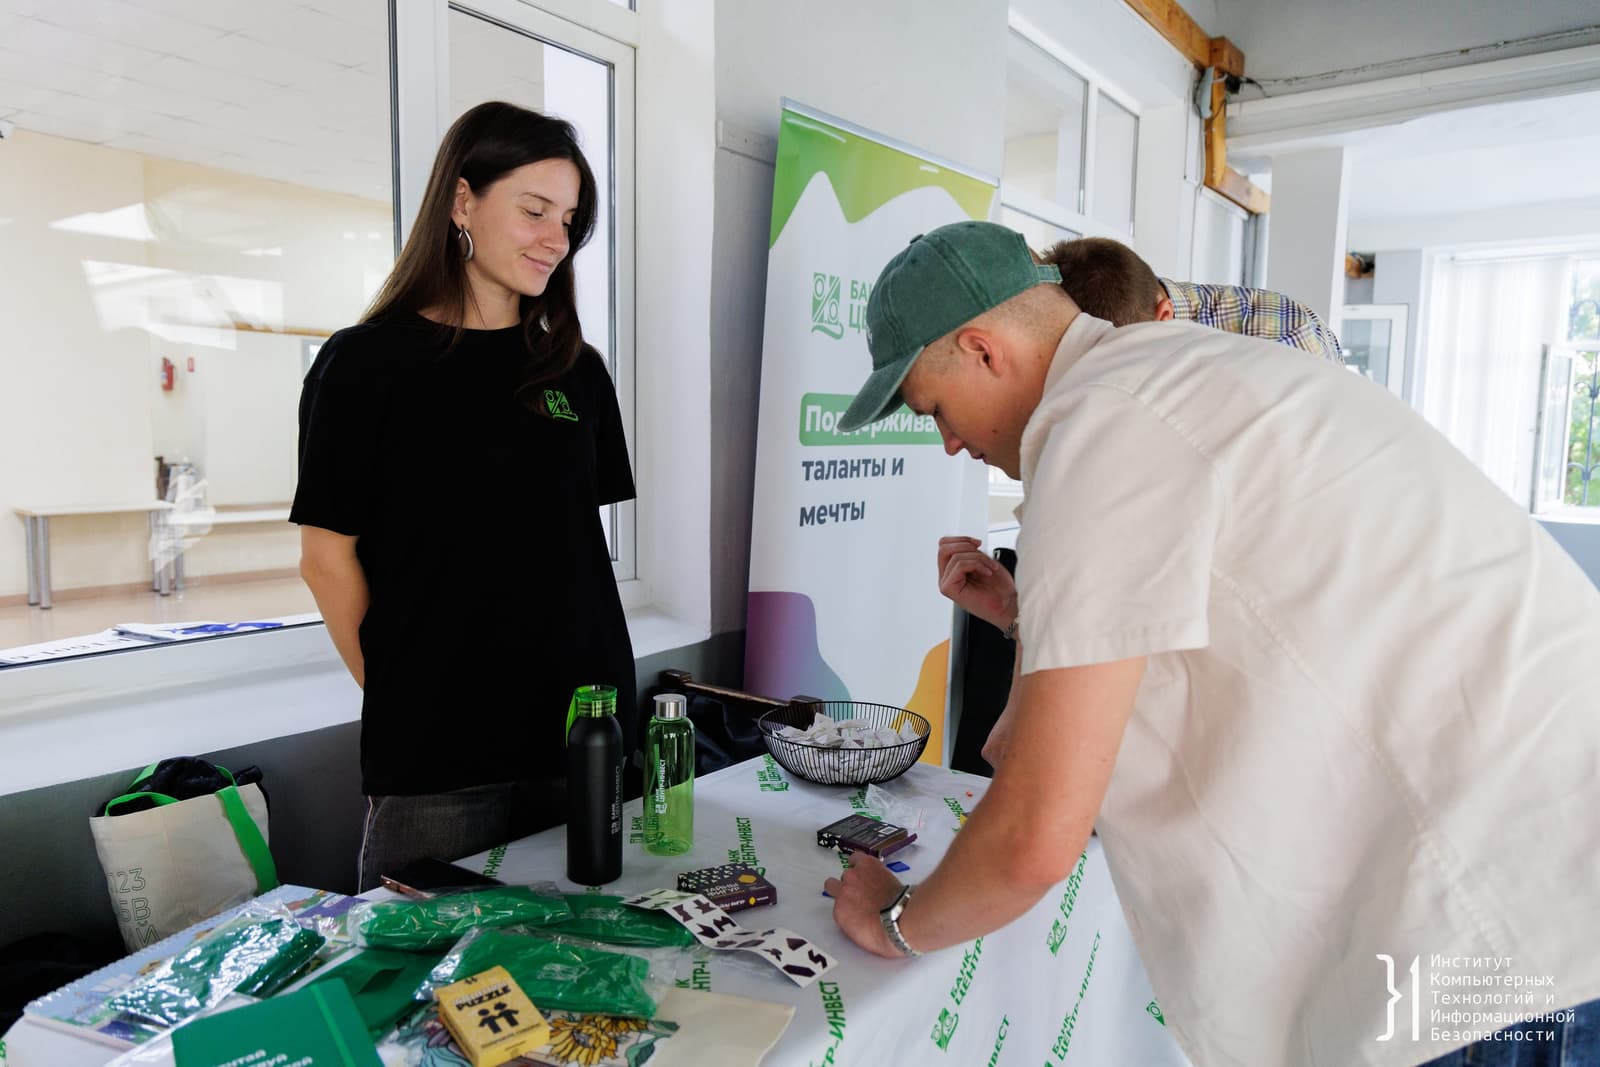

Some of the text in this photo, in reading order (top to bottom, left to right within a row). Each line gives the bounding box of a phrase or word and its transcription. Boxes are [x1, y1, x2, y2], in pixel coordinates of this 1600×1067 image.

[802, 457, 904, 481] таланты и
[799, 501, 865, 527] мечты
[728, 849, 740, 862] АНК
[1060, 872, 1076, 913] БАНК
[950, 949, 971, 999] БАНК
[956, 936, 984, 1006] ЦЕНТР
[455, 984, 512, 1012] PUZZLE
[1057, 928, 1102, 1062] ЦЕНТР-ИНВЕСТ
[1052, 1012, 1072, 1055] БАНК
